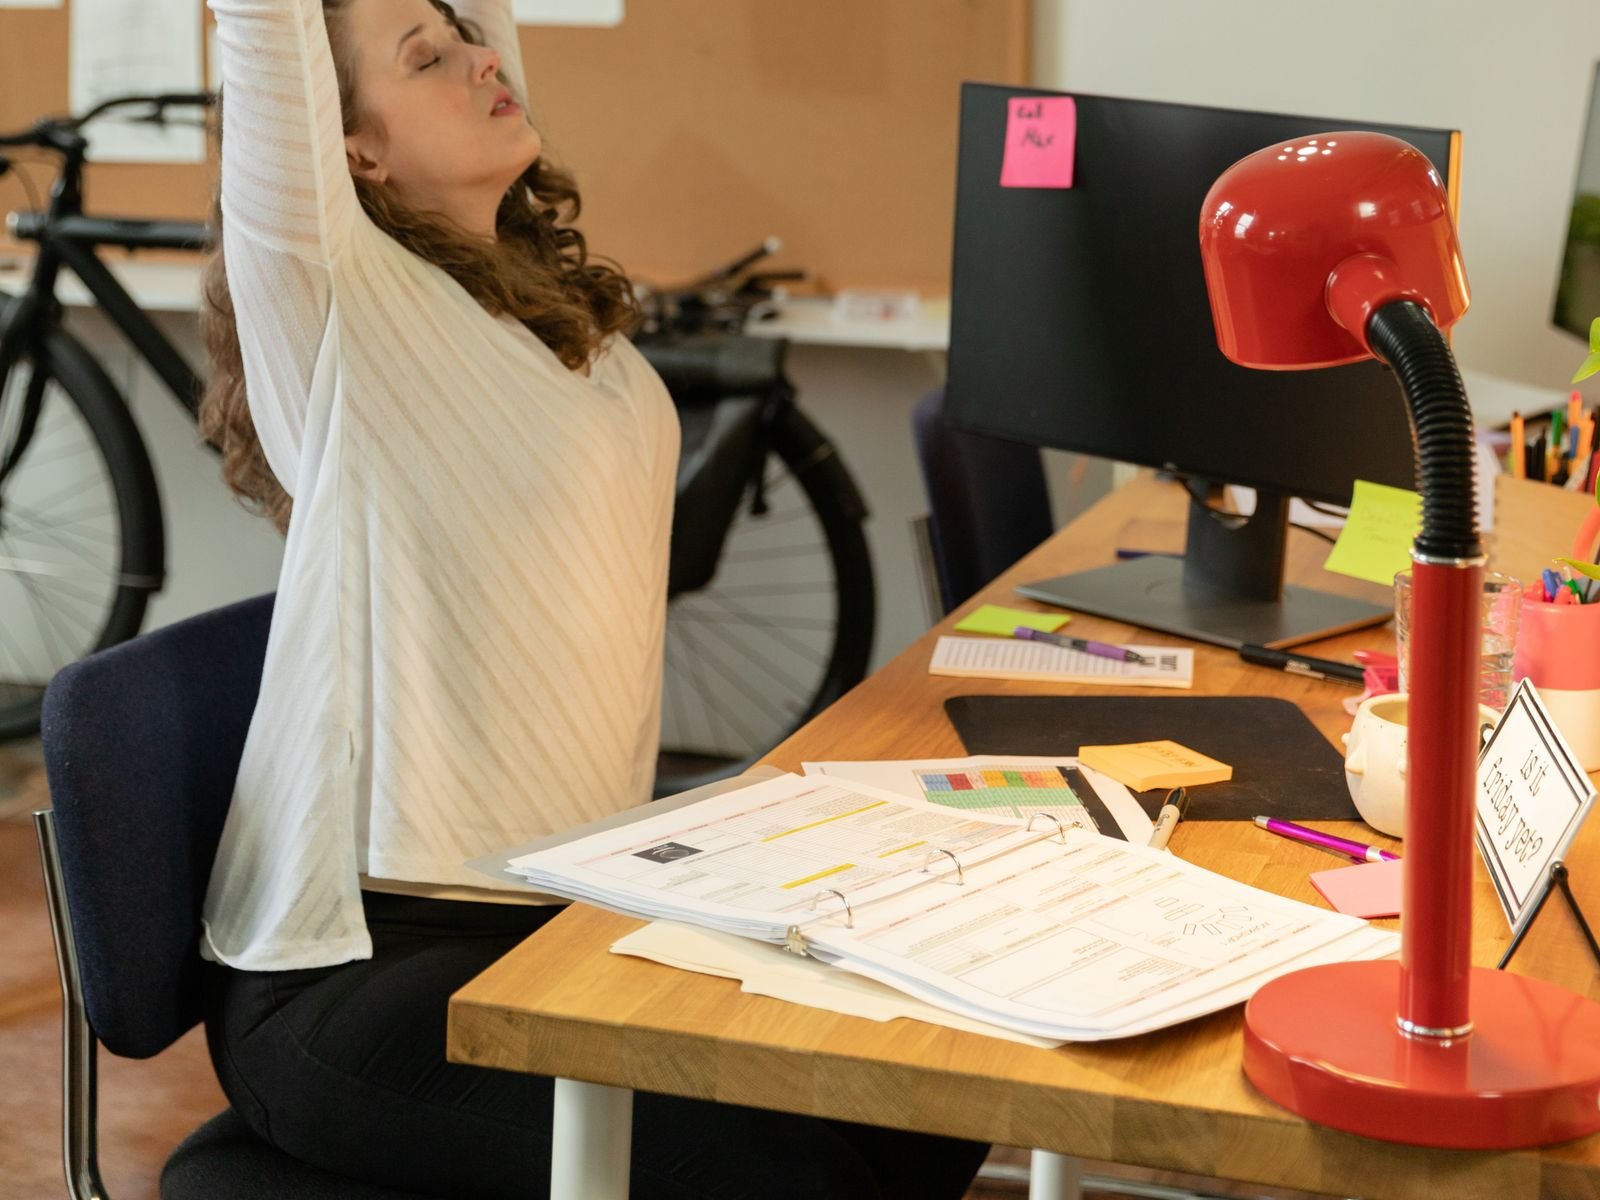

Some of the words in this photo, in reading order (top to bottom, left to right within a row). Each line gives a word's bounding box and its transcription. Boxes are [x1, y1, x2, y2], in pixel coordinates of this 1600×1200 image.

[1520, 744, 1538, 780] is
[1529, 761, 1549, 797] it
[1483, 757, 1519, 836] friday
[1505, 817, 1544, 868] yet?
